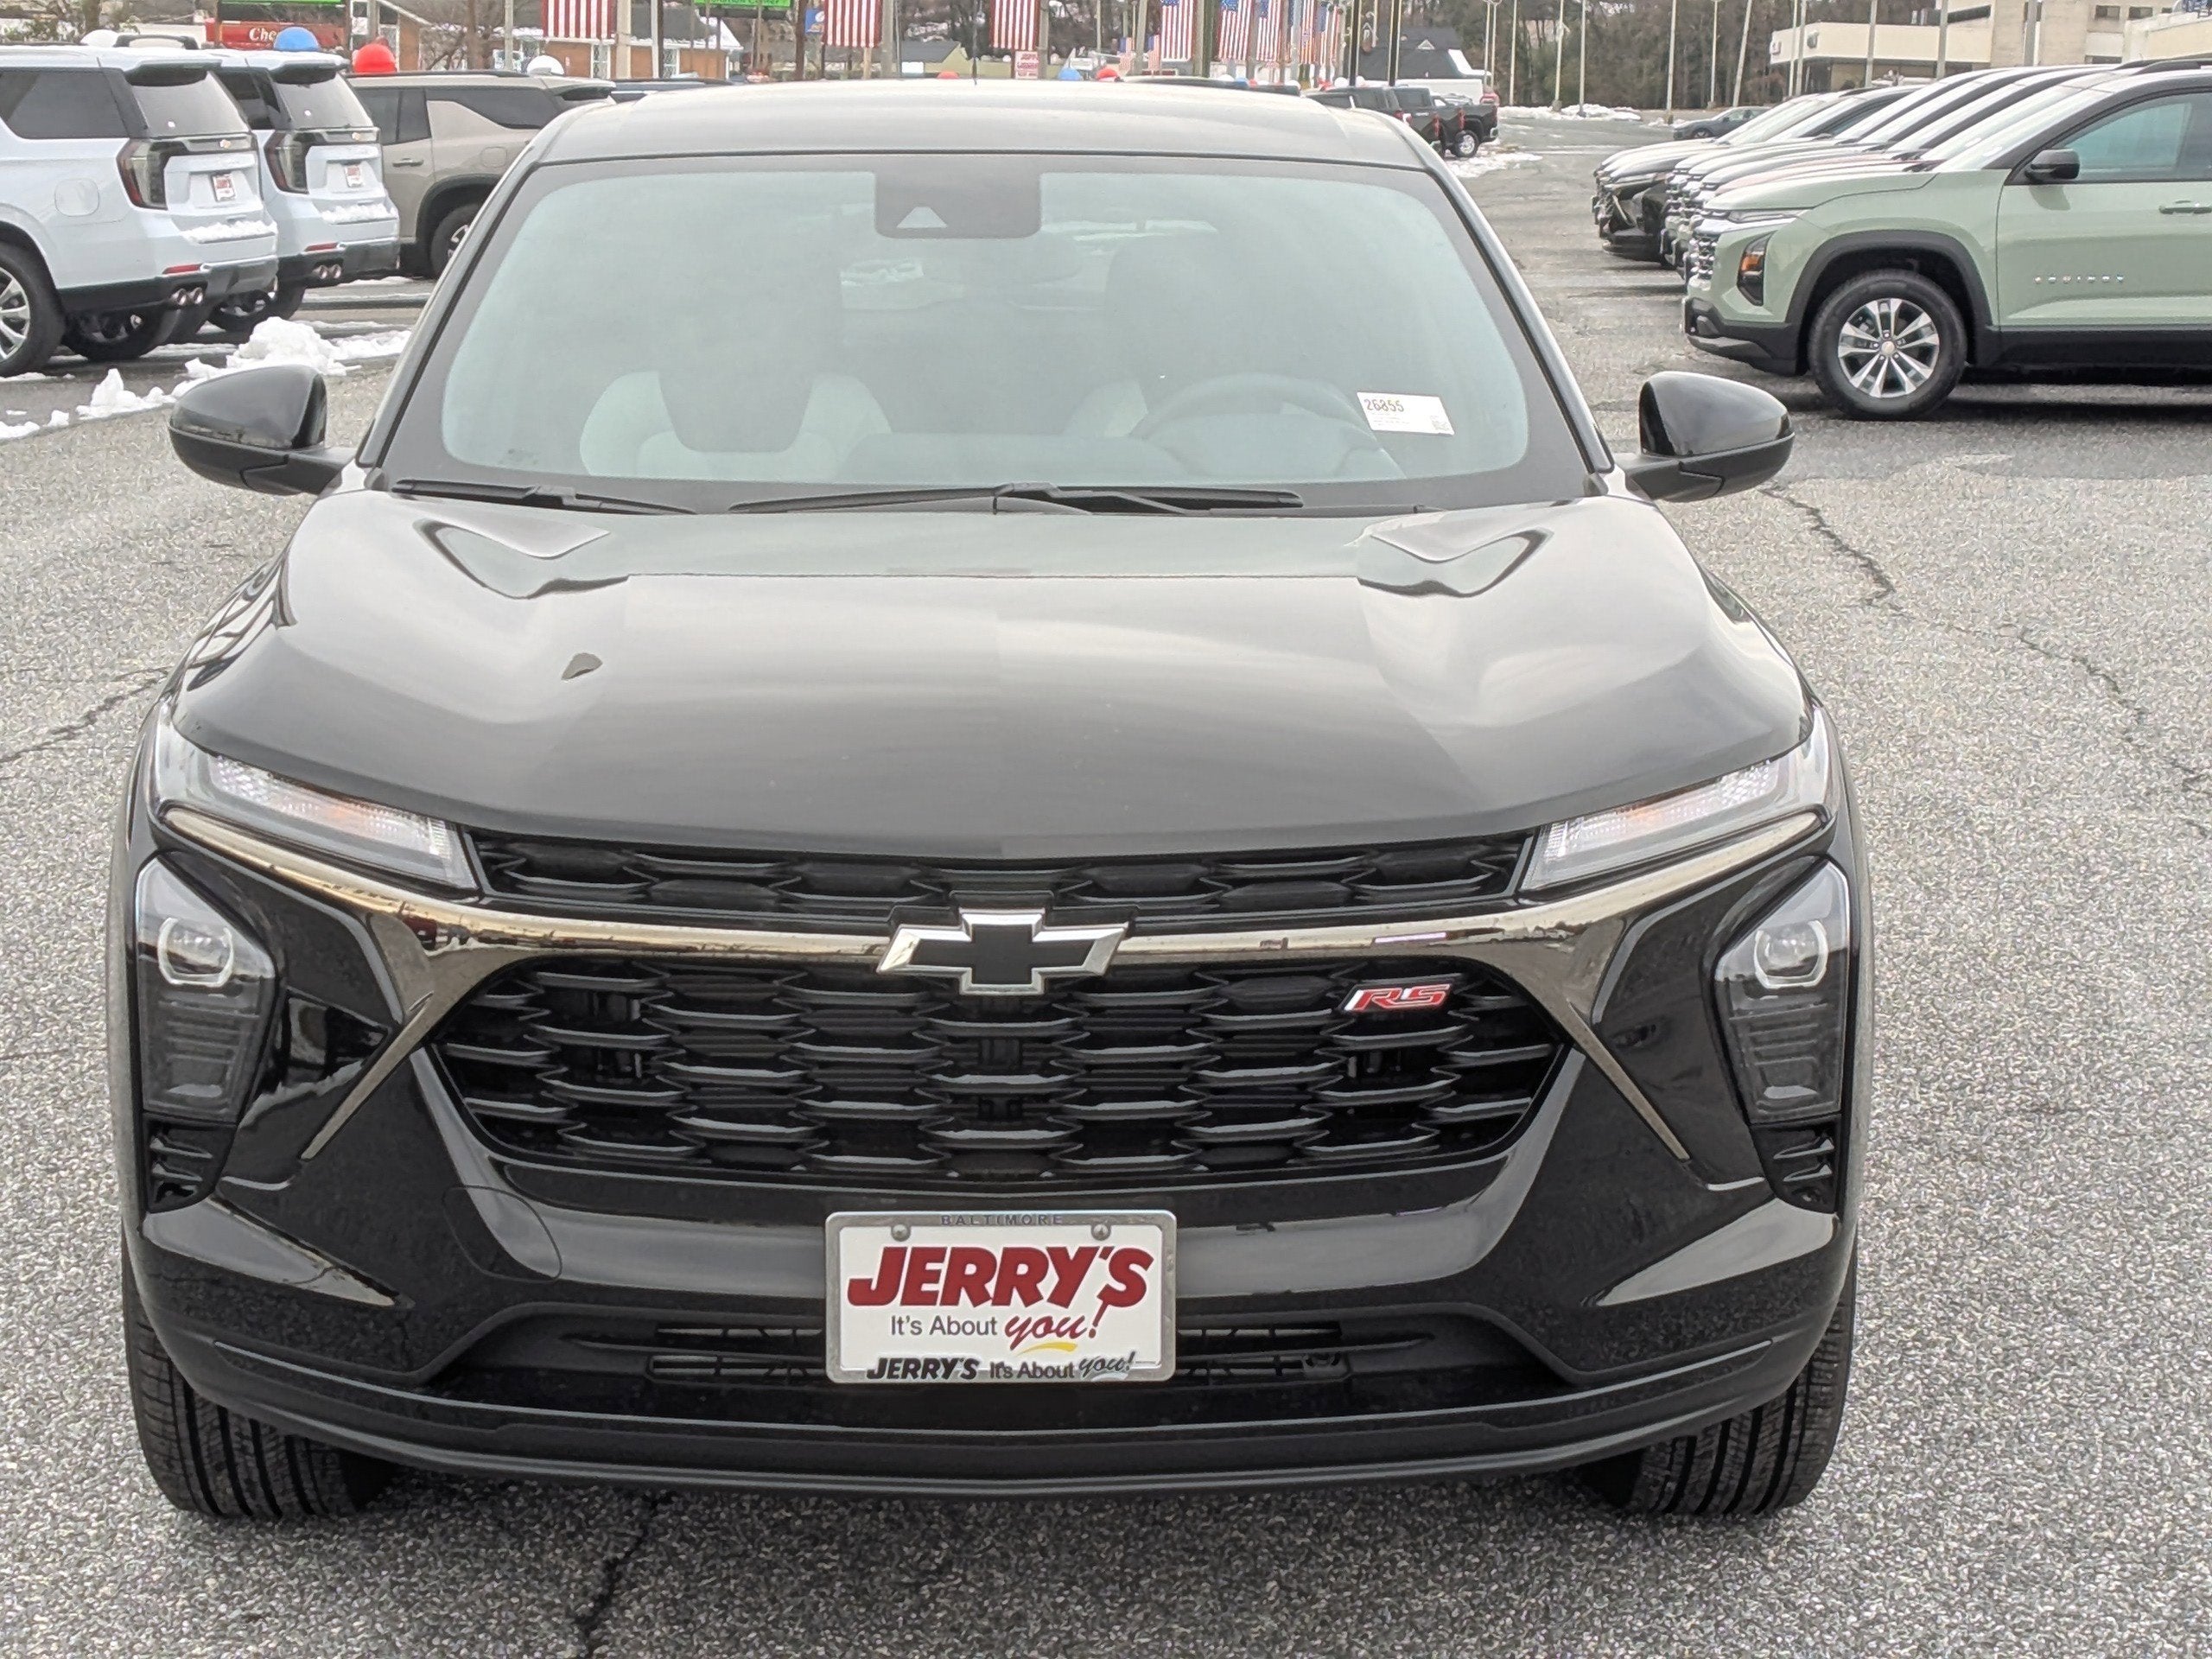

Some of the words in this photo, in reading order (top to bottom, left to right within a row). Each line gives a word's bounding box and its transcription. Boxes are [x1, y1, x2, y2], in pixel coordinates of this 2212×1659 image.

[249, 28, 277, 41] Che
[1363, 398, 1405, 412] 26855
[1344, 983, 1452, 1012] RS
[941, 1214, 1063, 1226] BALTIMORE
[847, 1245, 1154, 1309] JERRY'S
[891, 1315, 922, 1336] It's
[929, 1315, 998, 1336] About
[1004, 1300, 1110, 1351] you!
[867, 1357, 980, 1381] JERRY'S
[989, 1361, 1013, 1378] It's
[1016, 1361, 1075, 1378] About
[1077, 1351, 1136, 1376] you!
